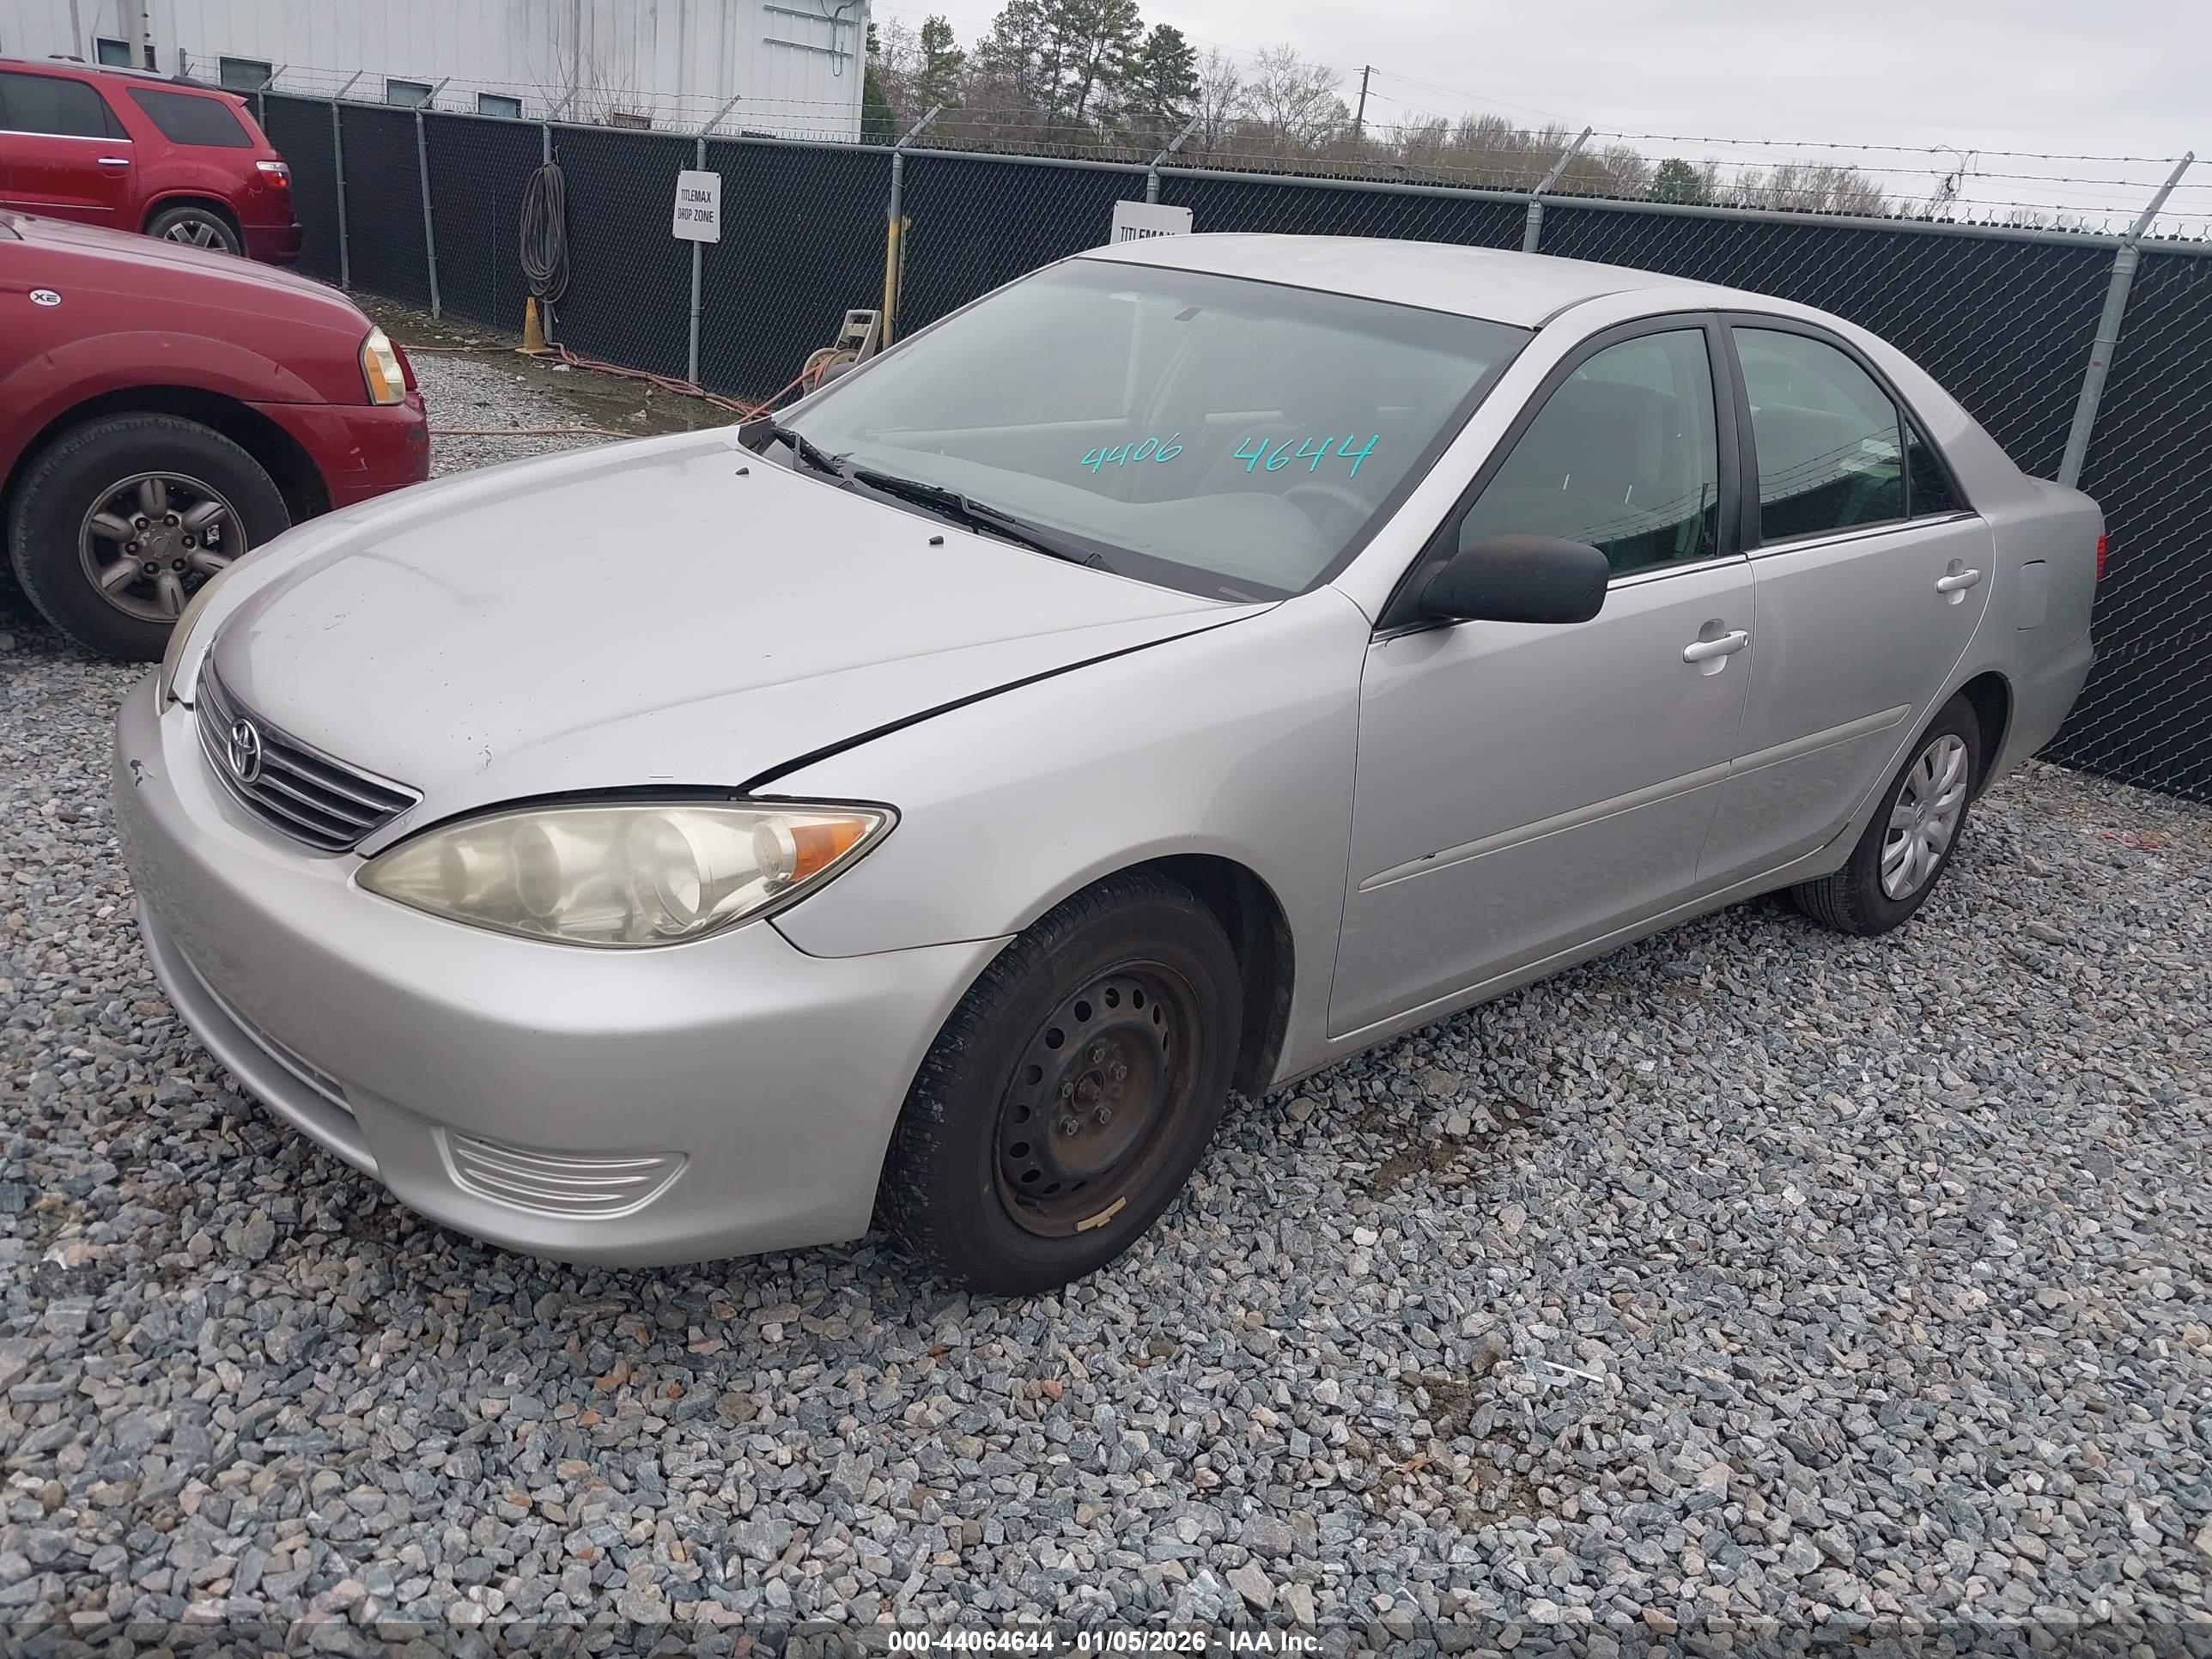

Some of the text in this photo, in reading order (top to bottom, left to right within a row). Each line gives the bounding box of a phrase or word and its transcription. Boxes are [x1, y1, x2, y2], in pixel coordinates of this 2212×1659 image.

[681, 189, 711, 204] TITLEMAX
[678, 207, 714, 223] DROP ZONE
[33, 292, 58, 302] XE
[1080, 432, 1379, 480] 4406 4644
